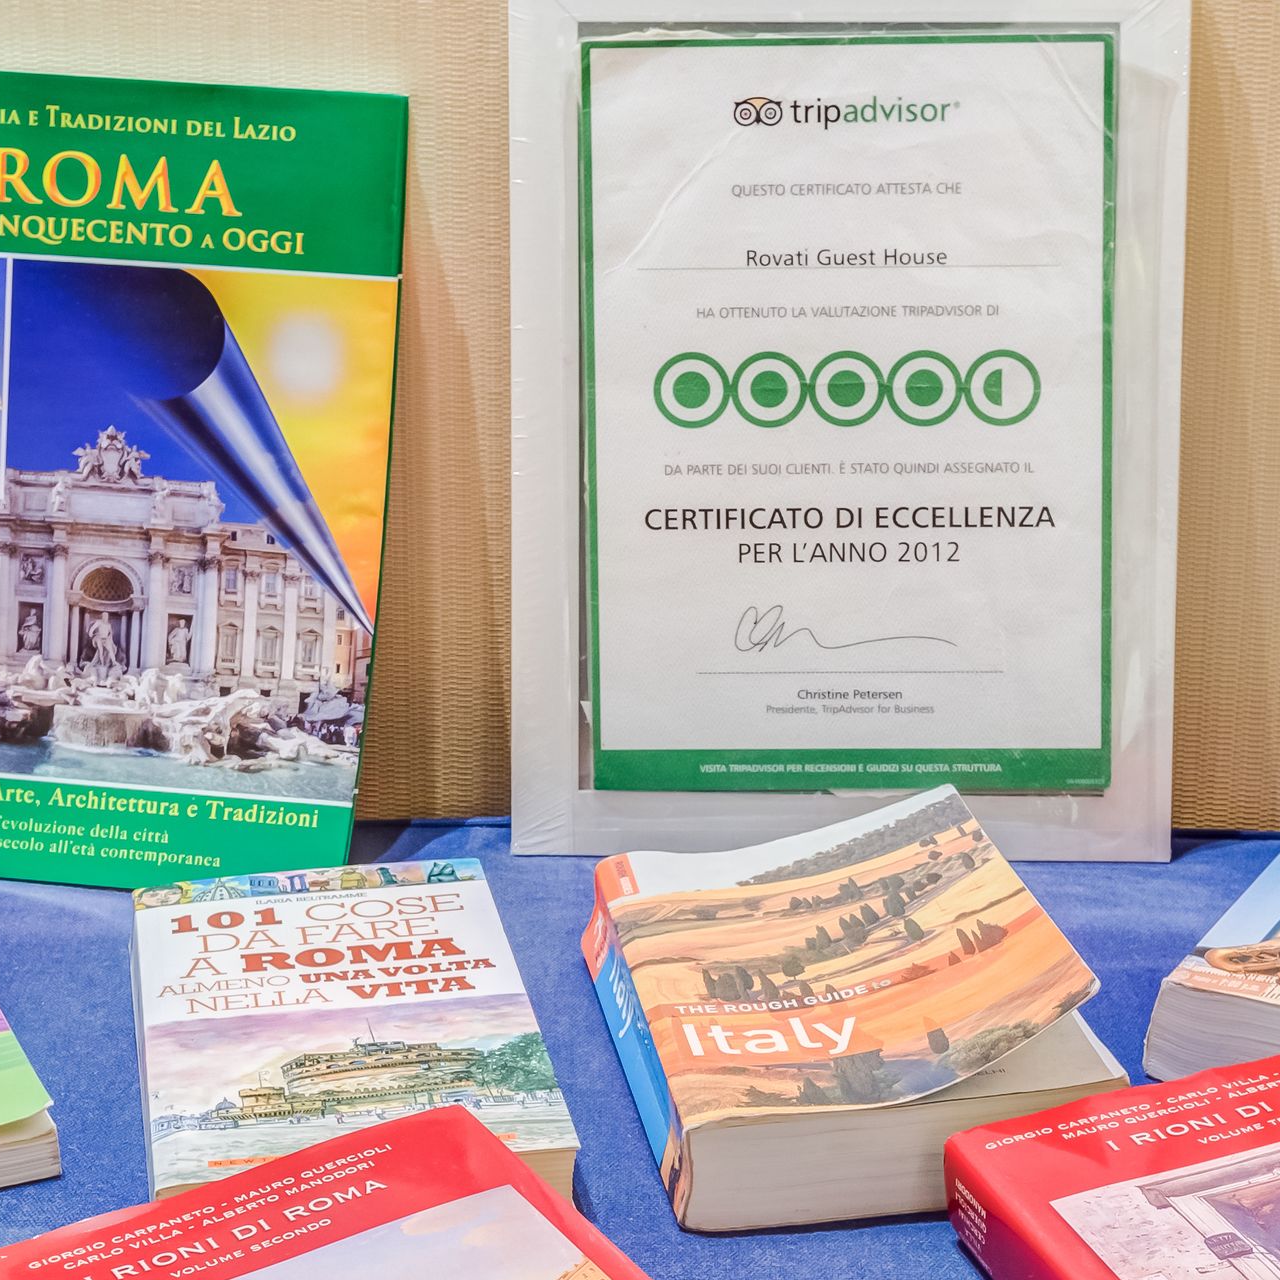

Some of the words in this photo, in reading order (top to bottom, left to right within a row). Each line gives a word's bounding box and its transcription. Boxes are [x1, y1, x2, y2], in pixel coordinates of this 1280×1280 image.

[790, 96, 950, 130] tripadvisor
[731, 183, 786, 196] QUESTO
[790, 183, 872, 196] CERTIFICATO
[876, 182, 932, 196] ATTESTA
[936, 182, 962, 196] CHE
[200, 234, 215, 249] A
[222, 228, 305, 255] OGGI
[745, 248, 809, 268] Rovati
[816, 249, 876, 266] Guest
[884, 249, 948, 266] House
[696, 307, 715, 319] HA
[719, 307, 787, 319] OTTENUTO
[791, 307, 807, 318] LA
[811, 306, 897, 318] VALUTAZIONE
[901, 305, 981, 317] TRIPADVISOR
[986, 305, 999, 317] DI
[664, 464, 682, 476] DA
[686, 463, 723, 476] PARTE
[727, 463, 747, 475] DEI
[751, 462, 782, 475] SUOI
[850, 462, 889, 474] STATO
[893, 461, 940, 476] QUINDI
[943, 461, 1020, 474] ASSEGNATO
[1024, 462, 1034, 473] IL
[644, 507, 824, 530] CERTIFICATO
[836, 507, 863, 528] DI
[875, 506, 1056, 528] ECCELLENZA
[738, 543, 783, 563] PER
[898, 542, 960, 562] 2012
[797, 689, 849, 700] Christine
[853, 689, 902, 700] Petersen
[822, 704, 873, 716] TripAdvisor
[877, 704, 891, 714] for
[894, 704, 934, 714] Business
[48, 788, 180, 817] Architettura
[206, 800, 319, 829] Tradizioni
[89, 823, 127, 841] della
[132, 825, 169, 844] città
[100, 845, 221, 868] contemporanea
[171, 907, 282, 934] 101
[306, 893, 464, 922] COSE
[197, 929, 280, 953] DA
[296, 916, 441, 945] FARE
[184, 956, 232, 979] A
[241, 937, 465, 973] ROMA
[157, 974, 291, 997] ALMENO
[299, 969, 373, 984] UNA
[377, 958, 496, 978] VOLTA
[186, 988, 334, 1014] NELLA
[347, 976, 475, 999] VITA
[675, 1004, 718, 1015] THE
[723, 997, 797, 1013] ROUGH
[803, 985, 868, 1007] GUIDE
[872, 978, 891, 991] to
[681, 1016, 857, 1056] Italy
[1108, 1139, 1120, 1152] I
[1130, 1113, 1227, 1147] RIONI
[1241, 1101, 1272, 1121] DI
[1197, 1123, 1263, 1146] VOLUME
[111, 1237, 220, 1280] RIONI
[231, 1217, 272, 1242] DI
[283, 1178, 388, 1221] ROMA
[168, 1250, 246, 1279] VOLUME
[250, 1217, 333, 1253] SECONDO
